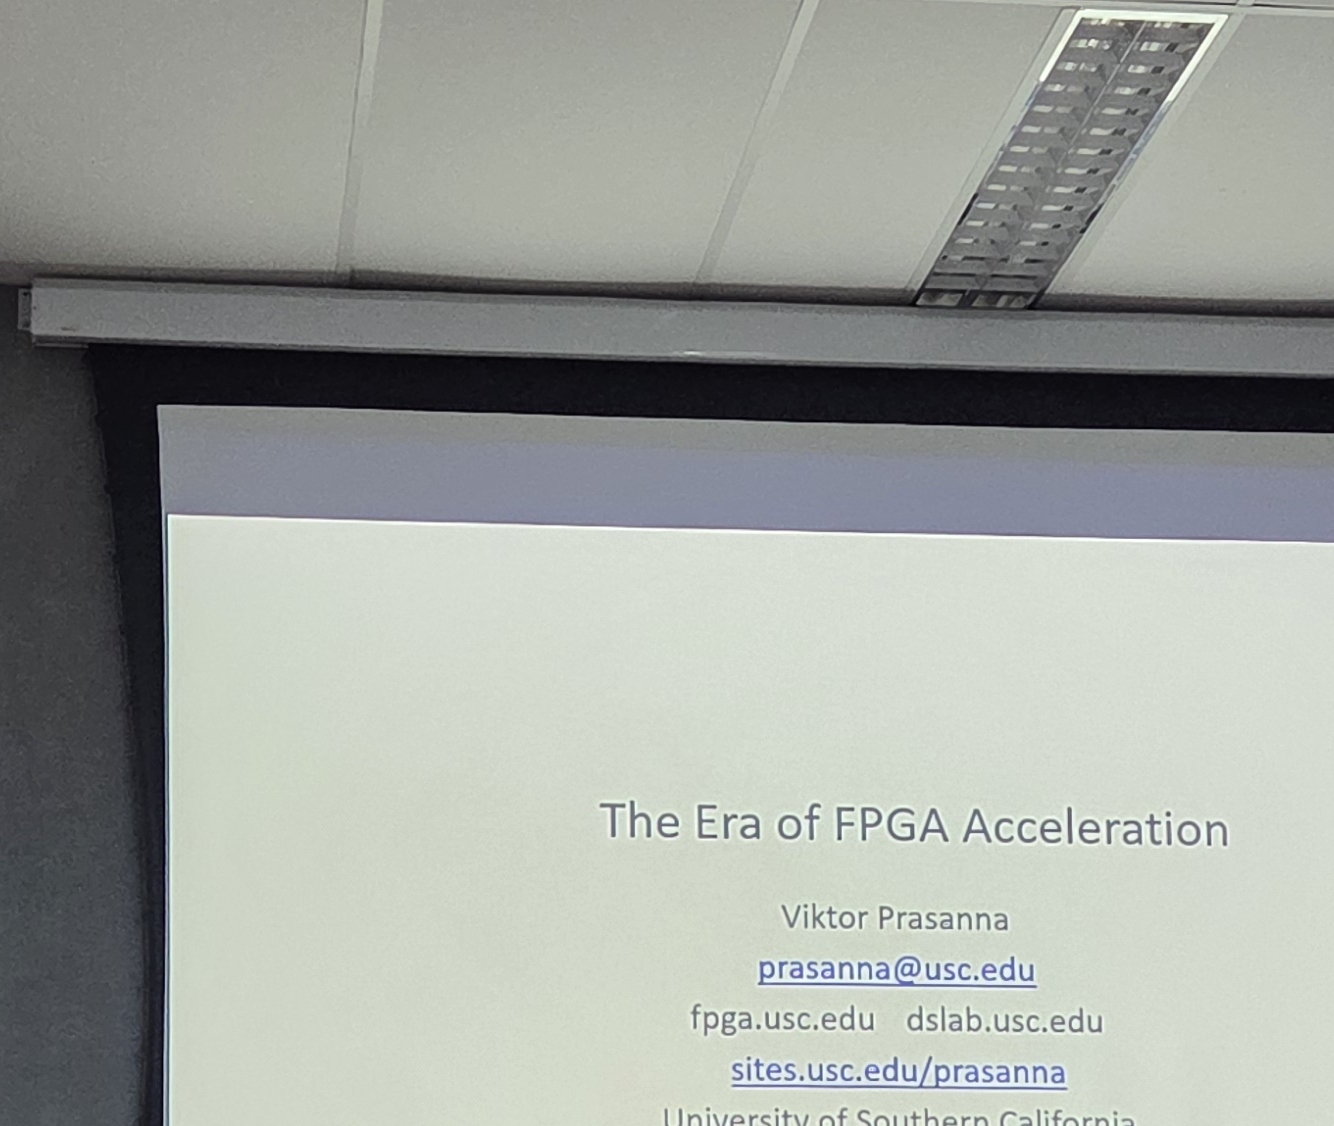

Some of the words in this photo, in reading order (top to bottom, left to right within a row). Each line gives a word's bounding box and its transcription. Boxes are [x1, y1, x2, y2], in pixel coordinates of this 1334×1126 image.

[600, 801, 680, 841] The
[696, 804, 761, 843] Era
[777, 803, 822, 843] of
[835, 807, 949, 844] FPGA
[963, 807, 1229, 848] Acceleration
[781, 903, 868, 931] Viktor
[878, 905, 1009, 932] Prasanna
[757, 955, 1037, 988] prasanna@usc.edu
[690, 1004, 875, 1036] fpga.usc.edu
[906, 1006, 1103, 1034] dslab.usc.edu
[731, 1056, 1067, 1089] sites.usc.edu/prasanna
